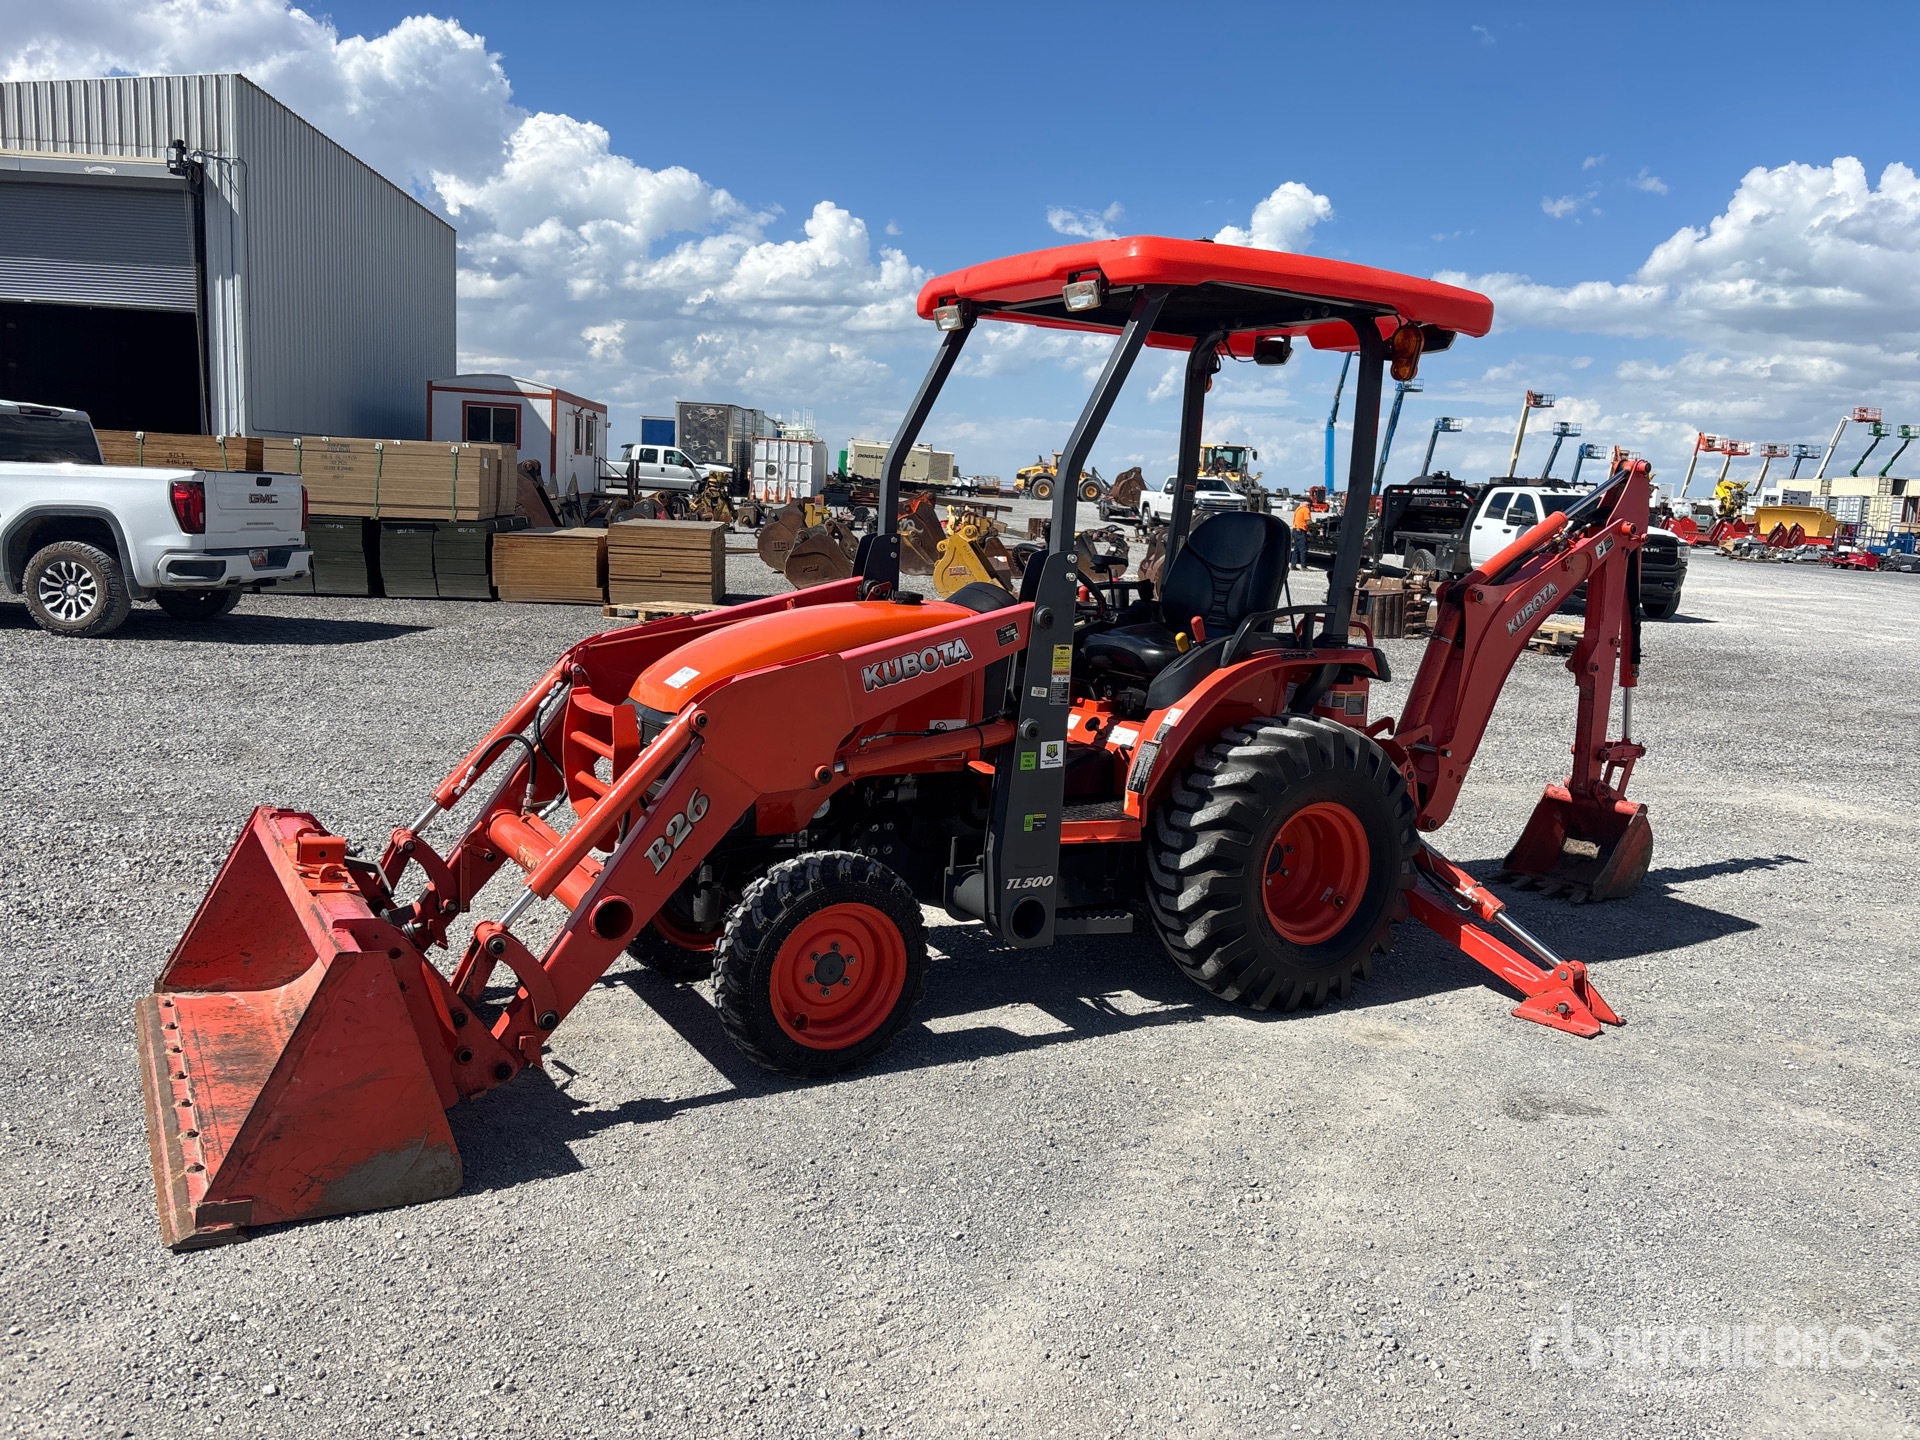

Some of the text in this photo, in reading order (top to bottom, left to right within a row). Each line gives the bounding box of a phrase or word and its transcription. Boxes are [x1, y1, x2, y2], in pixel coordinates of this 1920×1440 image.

[248, 493, 278, 504] GMC
[1506, 581, 1559, 638] KUBOTA
[861, 637, 974, 693] KUBOTA
[1047, 744, 1057, 753] 811
[643, 786, 710, 876] B26
[1005, 875, 1054, 890] TL500
